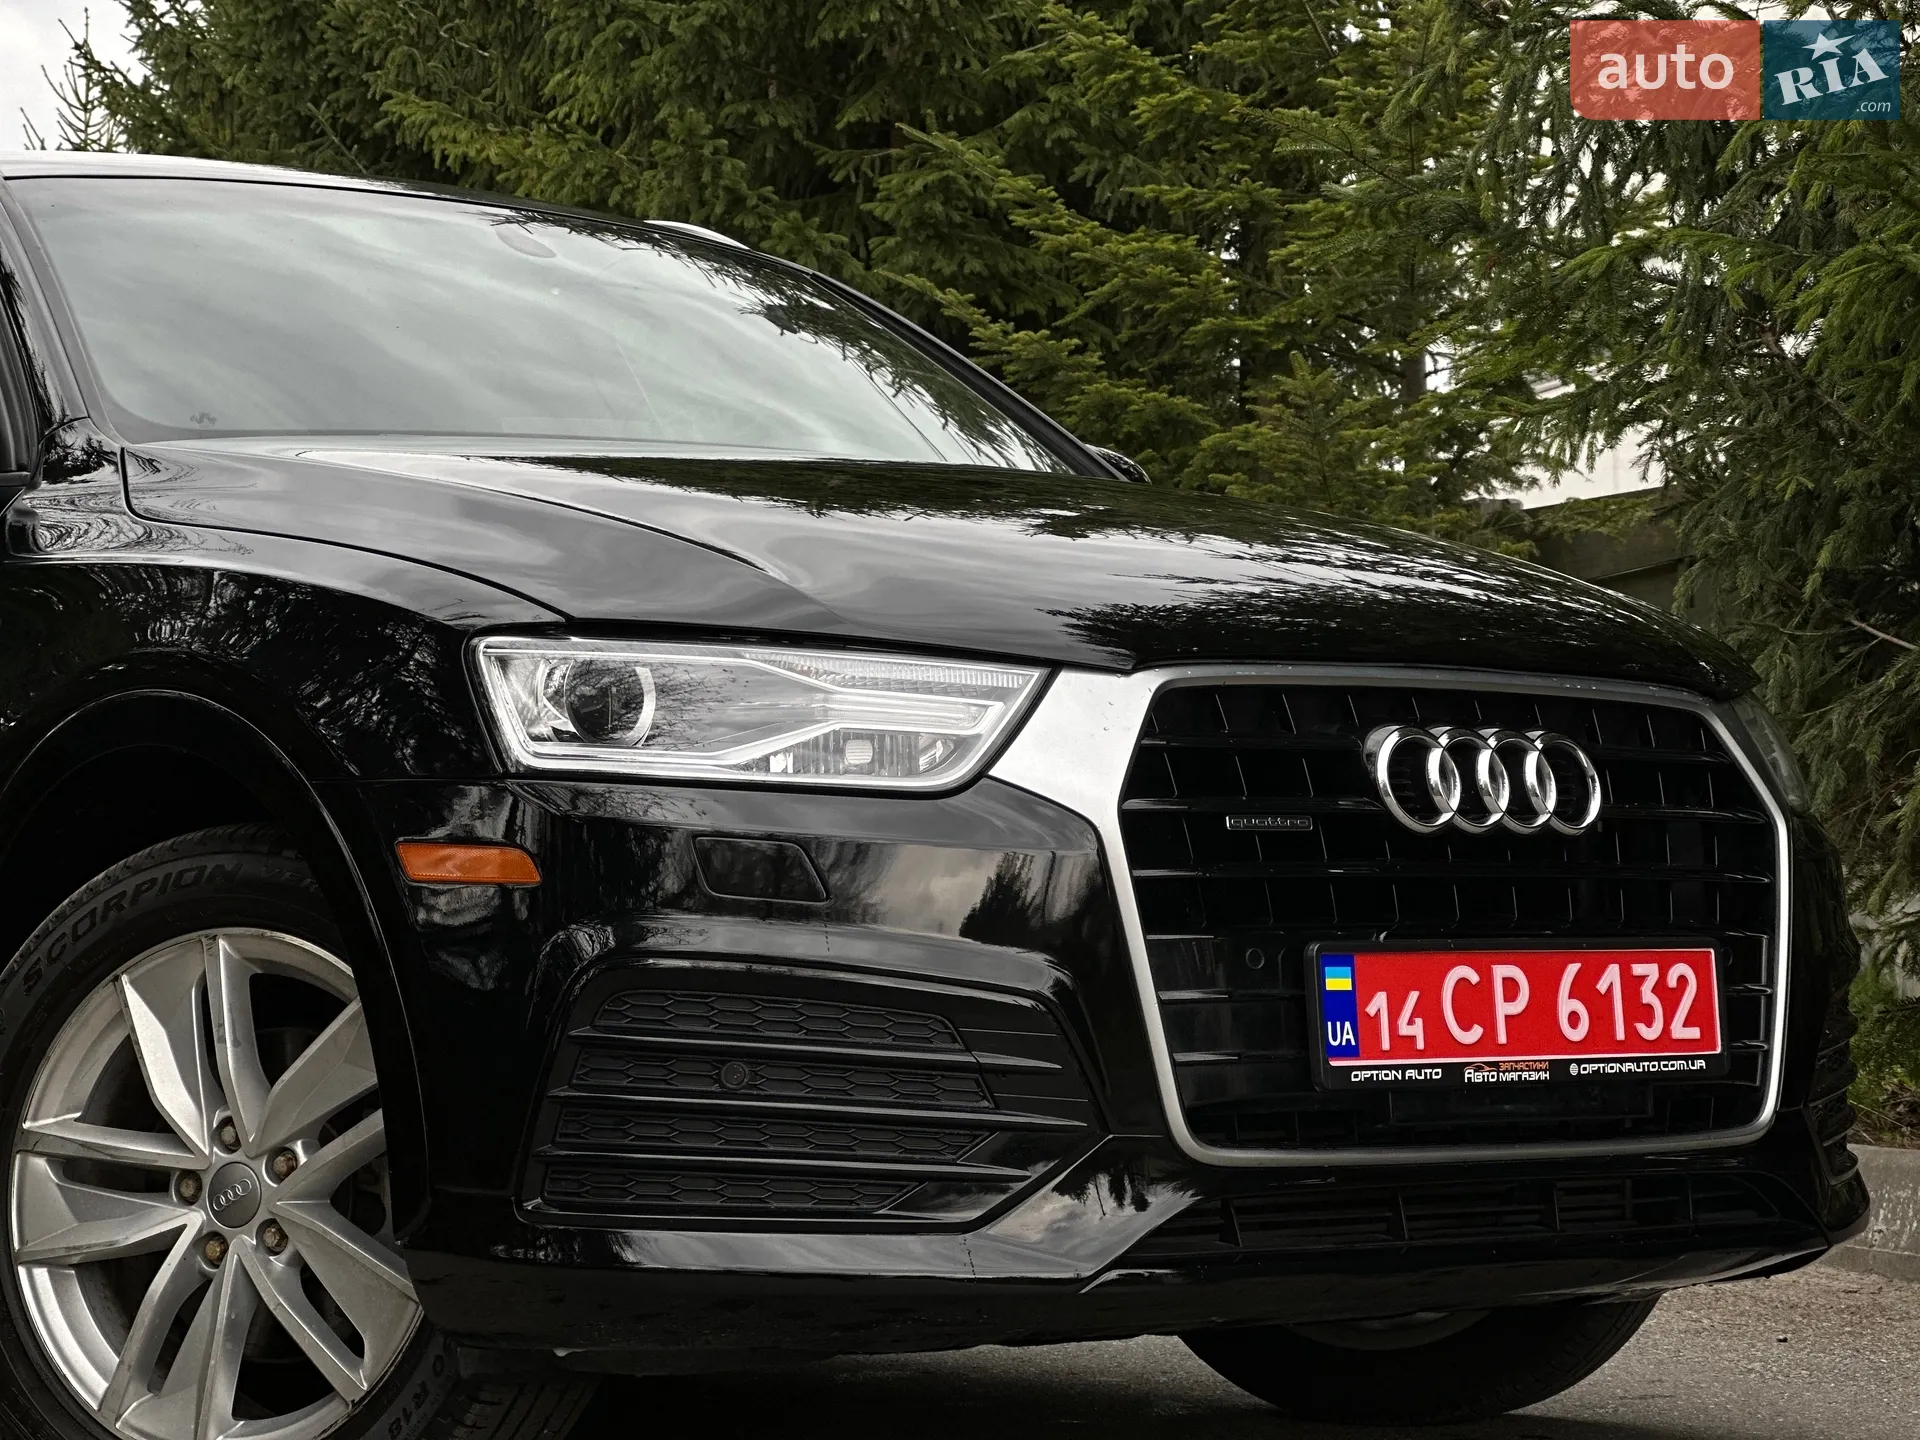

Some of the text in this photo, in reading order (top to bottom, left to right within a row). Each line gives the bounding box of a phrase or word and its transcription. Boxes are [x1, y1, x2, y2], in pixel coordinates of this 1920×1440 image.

[1231, 817, 1309, 829] quattro
[22, 863, 243, 996] SCORPION
[1364, 962, 1701, 1051] 14 CP 6132
[1327, 1021, 1356, 1047] UA
[1405, 1068, 1442, 1080] AUTO
[1499, 1061, 1549, 1070] ЗАПЧАСТИНИ
